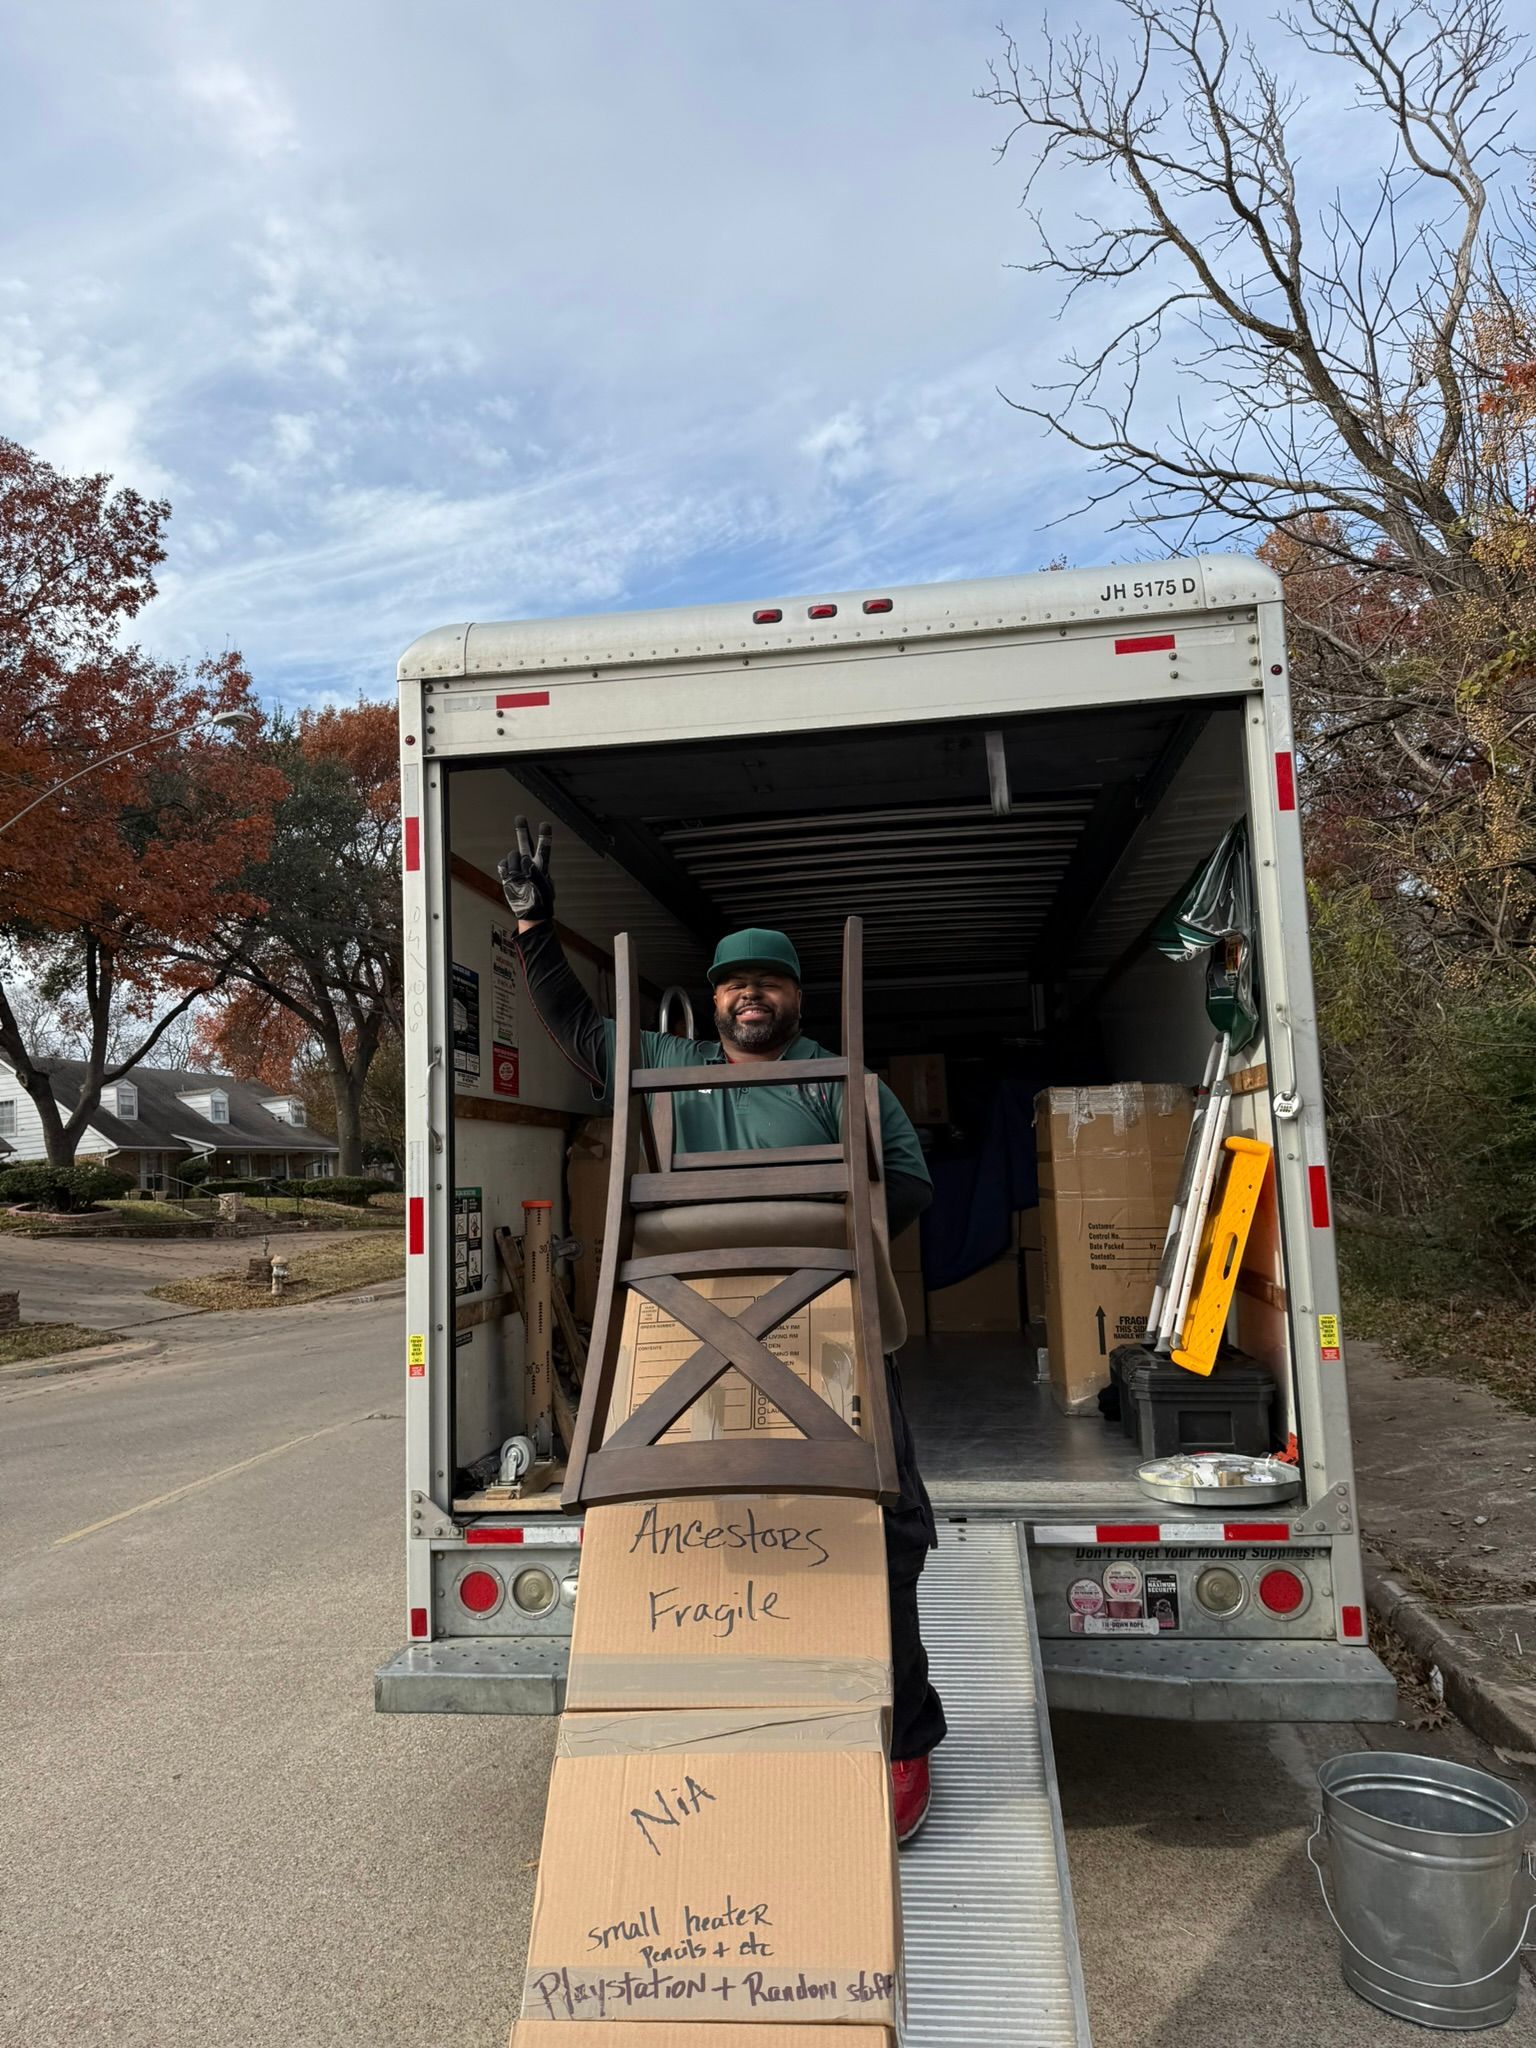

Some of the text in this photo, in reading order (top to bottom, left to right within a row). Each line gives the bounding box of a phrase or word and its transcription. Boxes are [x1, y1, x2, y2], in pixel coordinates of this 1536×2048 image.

[1100, 577, 1196, 601] JH 5175 D
[1088, 1222, 1115, 1230] Customer
[1089, 1232, 1110, 1240] Control
[1104, 1241, 1125, 1250] Packed
[1119, 1316, 1148, 1325] FRAGI
[1115, 1325, 1147, 1333] THIS SID
[1075, 1547, 1316, 1560] Don't Forget Your Moving Supplies!
[649, 1580, 790, 1638] Fragile
[587, 1906, 661, 1952] small
[739, 1931, 775, 1957] etc
[742, 1971, 837, 2006] Random
